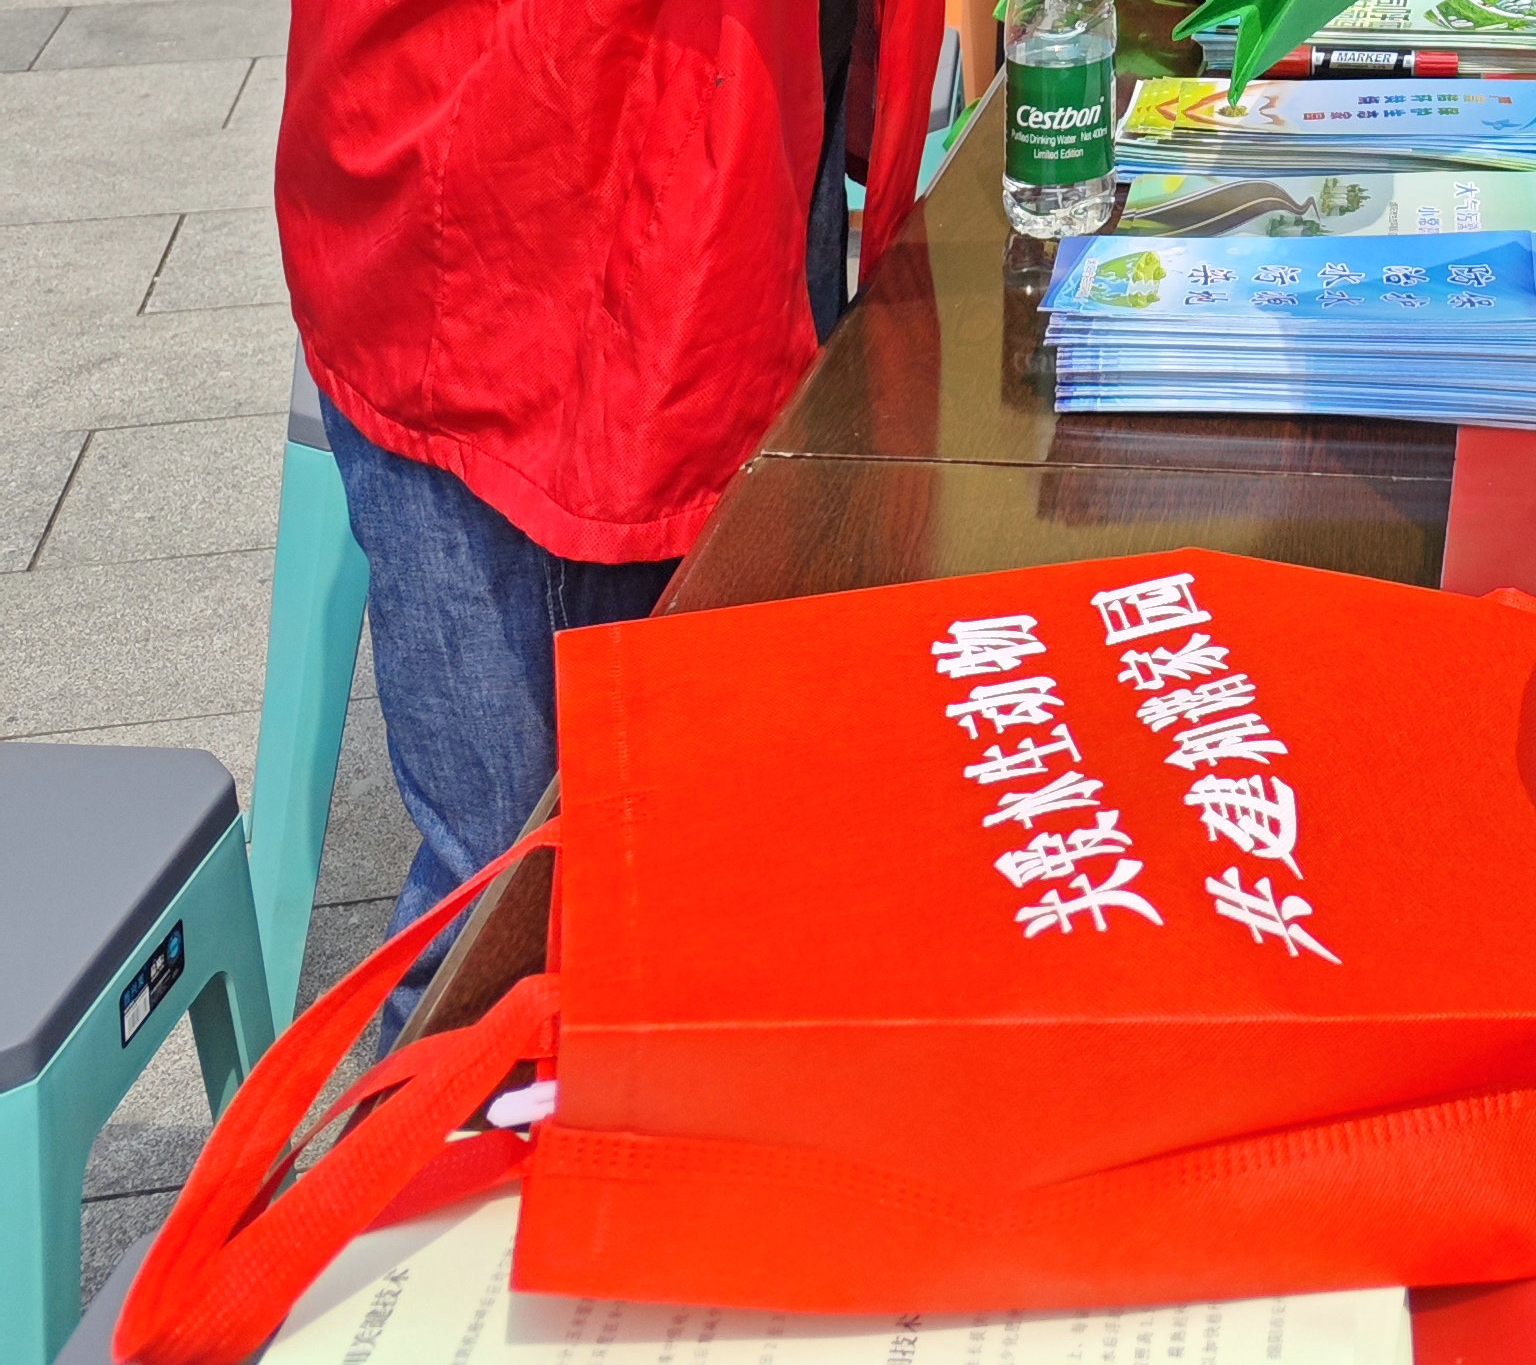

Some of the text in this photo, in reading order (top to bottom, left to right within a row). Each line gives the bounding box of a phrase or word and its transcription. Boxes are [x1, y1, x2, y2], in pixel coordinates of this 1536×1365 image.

[1336, 52, 1392, 63] MARKER
[1029, 134, 1056, 147] Drinking
[1057, 134, 1077, 145] Water
[1033, 147, 1084, 160] Limited Edition
[1185, 260, 1497, 291] 防治水污染
[1182, 287, 1497, 310] 保护水源地
[930, 613, 1165, 939] 关爱水生动物
[1090, 572, 1343, 966] 共建和谐家园
